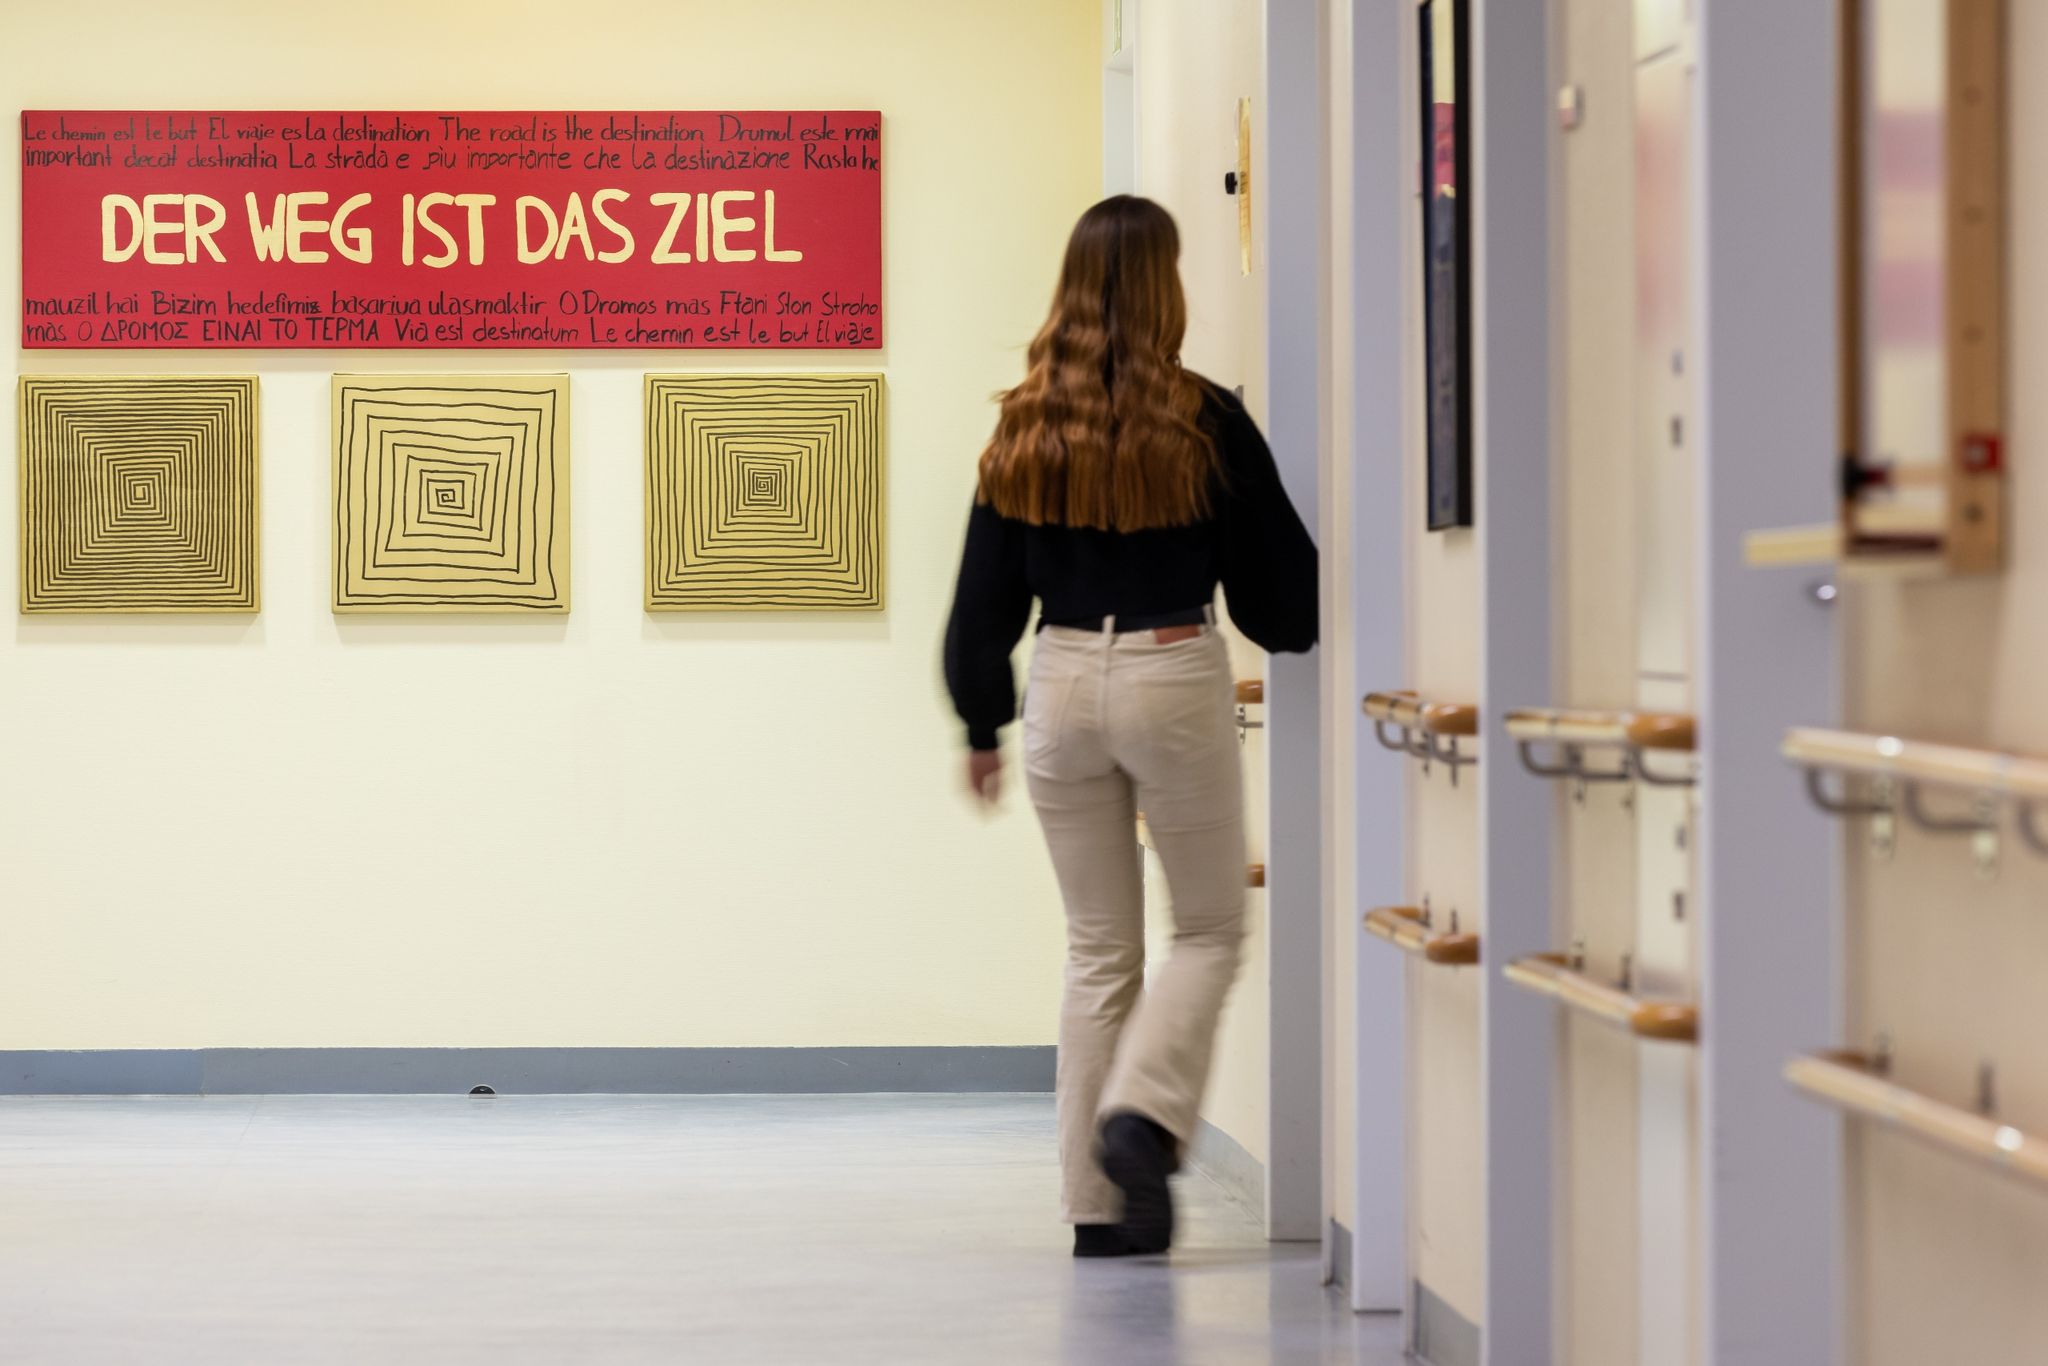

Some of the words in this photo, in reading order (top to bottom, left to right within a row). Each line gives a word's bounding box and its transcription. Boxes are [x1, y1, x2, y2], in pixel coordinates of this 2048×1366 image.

[25, 117, 46, 141] Le
[52, 117, 105, 141] chemin
[113, 118, 134, 140] est
[169, 117, 197, 140] but
[209, 117, 229, 140] El
[237, 124, 275, 141] viaje
[438, 116, 480, 142] The
[490, 116, 536, 142] road
[542, 122, 557, 141] is
[565, 115, 593, 141] the
[719, 114, 795, 142] Drumul
[800, 115, 839, 141] este
[845, 123, 878, 141] mai
[26, 146, 112, 167] important
[289, 143, 316, 169] La
[396, 153, 410, 169] e
[467, 143, 572, 170] importante
[584, 145, 621, 170] che
[664, 143, 790, 170] destinazione
[101, 191, 227, 264] DER
[245, 190, 374, 264] WEG
[402, 191, 497, 268] IST
[516, 188, 636, 263] DAS
[650, 189, 804, 264] ZIEL
[106, 291, 138, 315] hai
[152, 290, 217, 316] Bizim
[583, 289, 657, 316] Dromos
[776, 291, 812, 316] Ston
[395, 318, 429, 341] Via
[435, 318, 464, 341] est
[590, 317, 618, 344] Le
[625, 318, 694, 344] chemin
[703, 318, 740, 343] est
[779, 319, 809, 344] but
[816, 319, 831, 343] El
[834, 322, 875, 345] viaje
